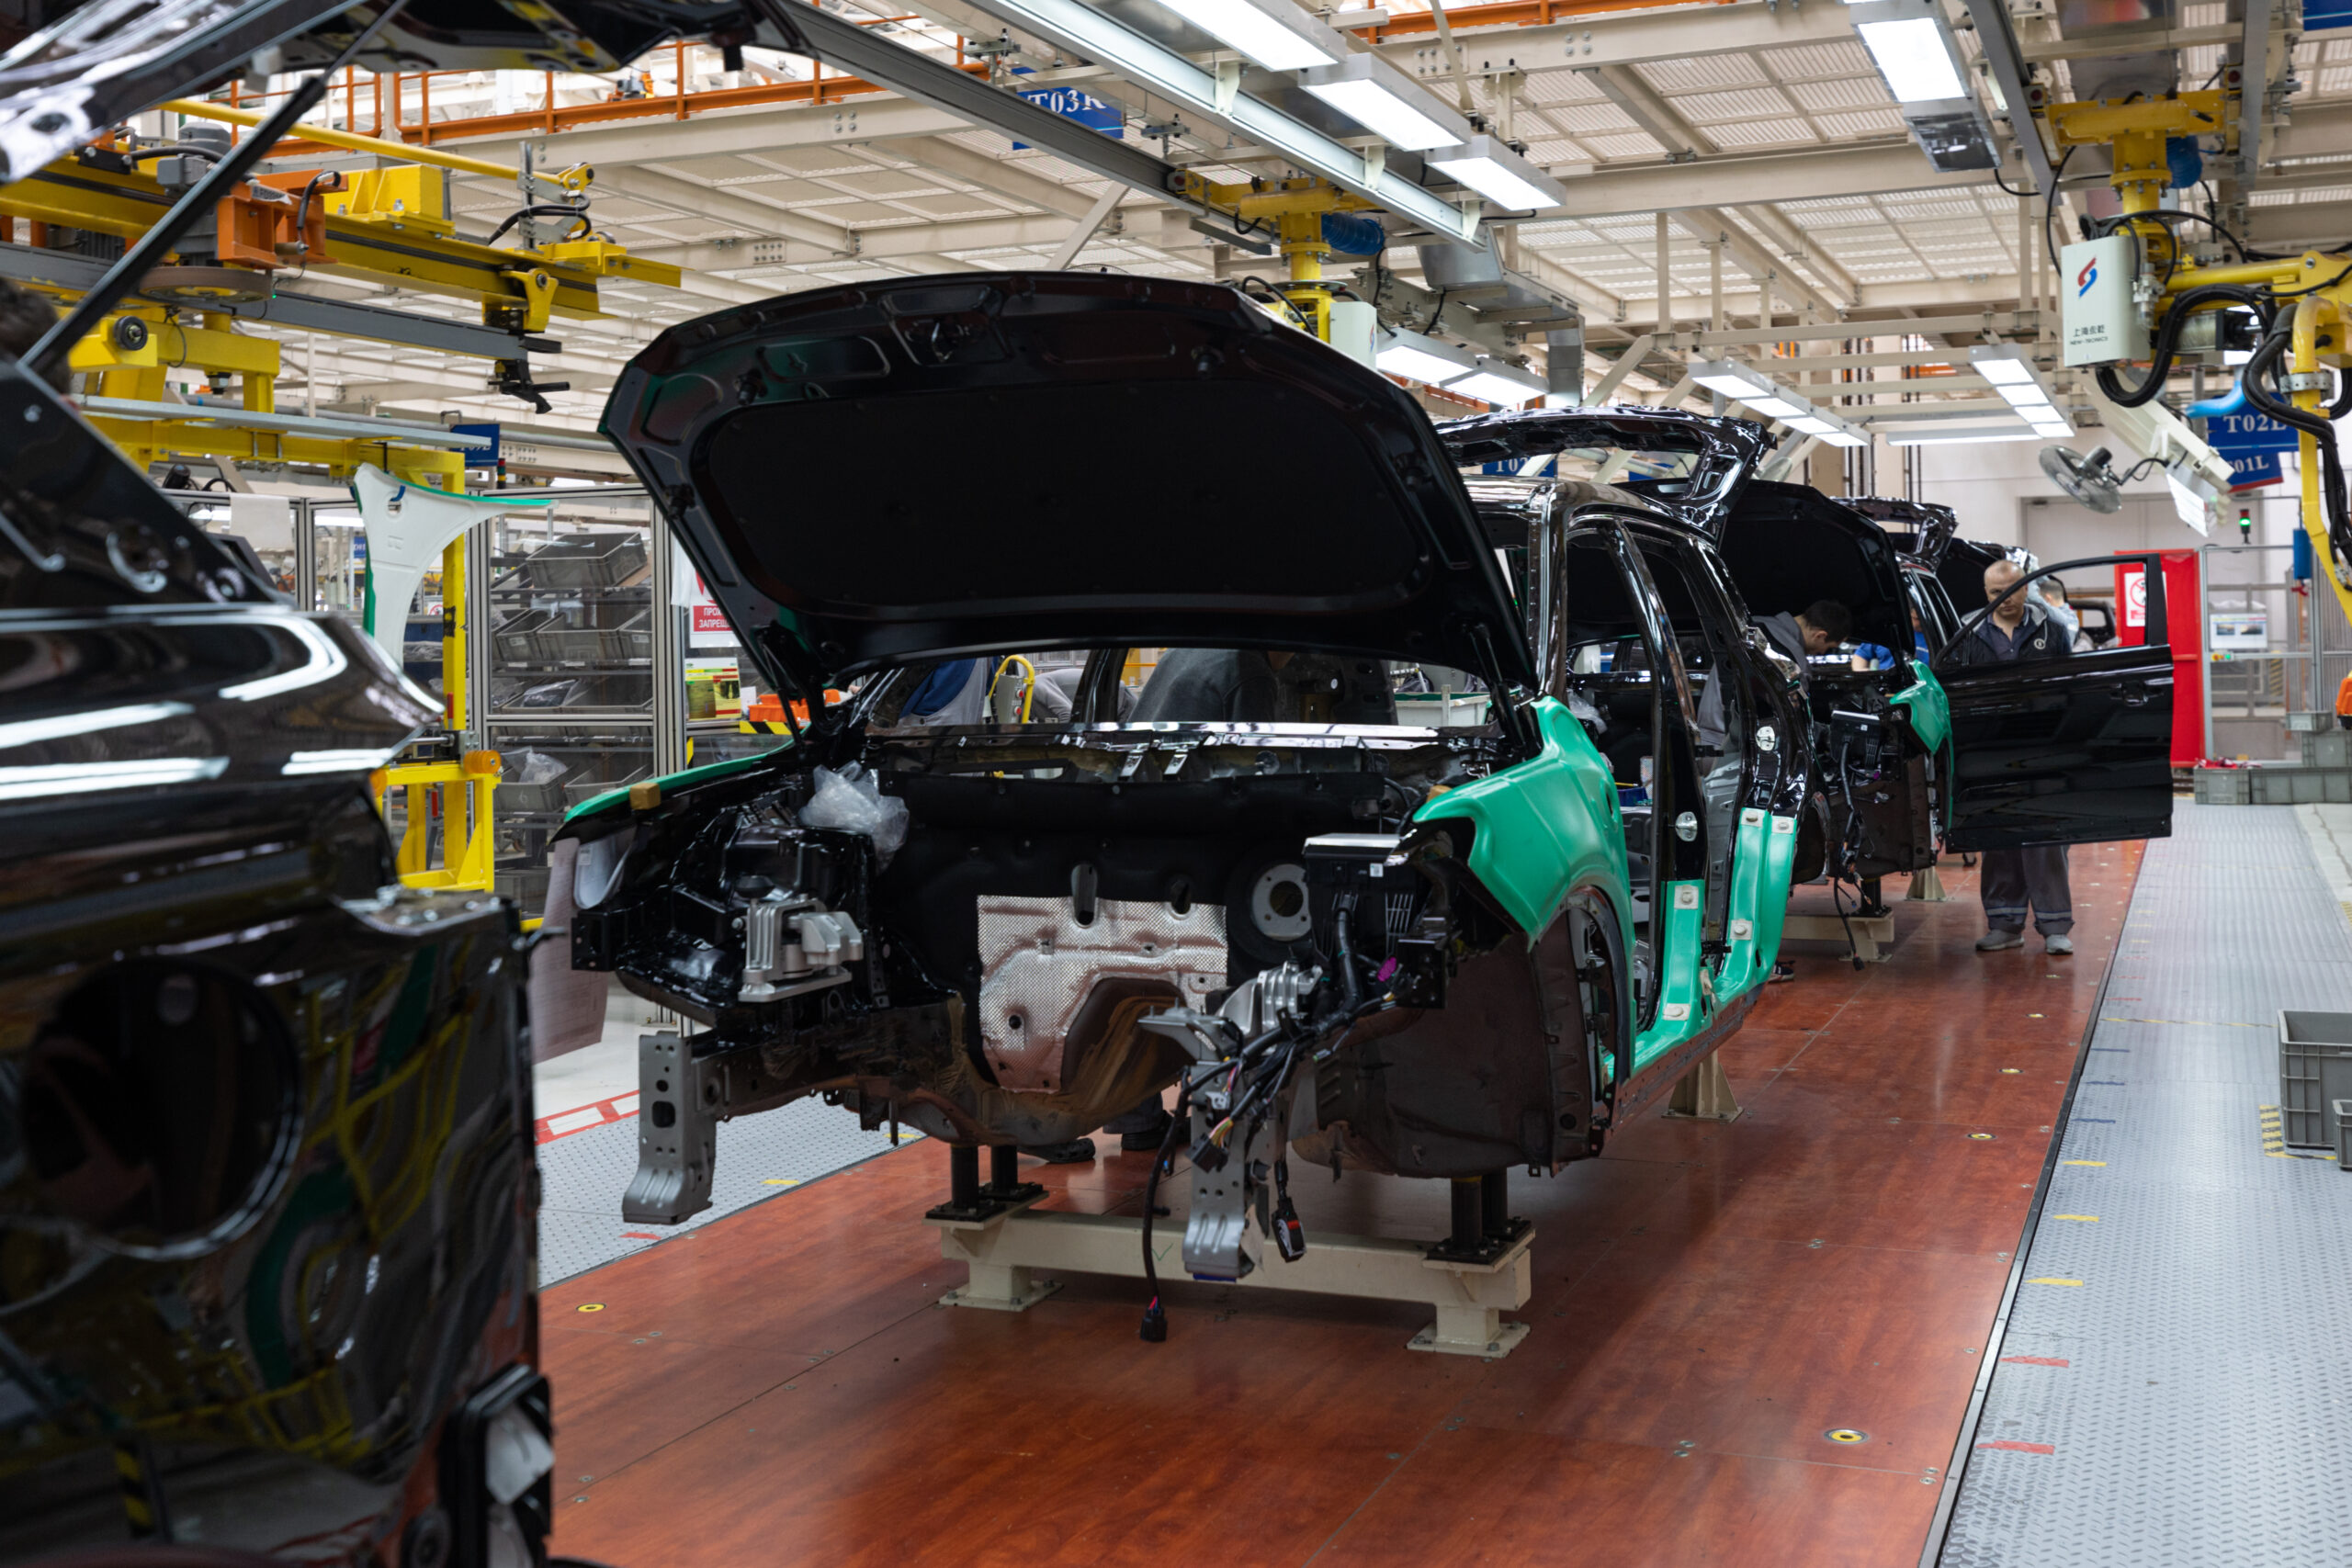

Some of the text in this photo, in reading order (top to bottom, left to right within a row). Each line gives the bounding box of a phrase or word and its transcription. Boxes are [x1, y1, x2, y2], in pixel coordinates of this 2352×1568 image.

[2223, 414, 2287, 434] T02L
[704, 607, 722, 616] ПРОХ
[698, 619, 730, 628] ЗАПРЕЩ
